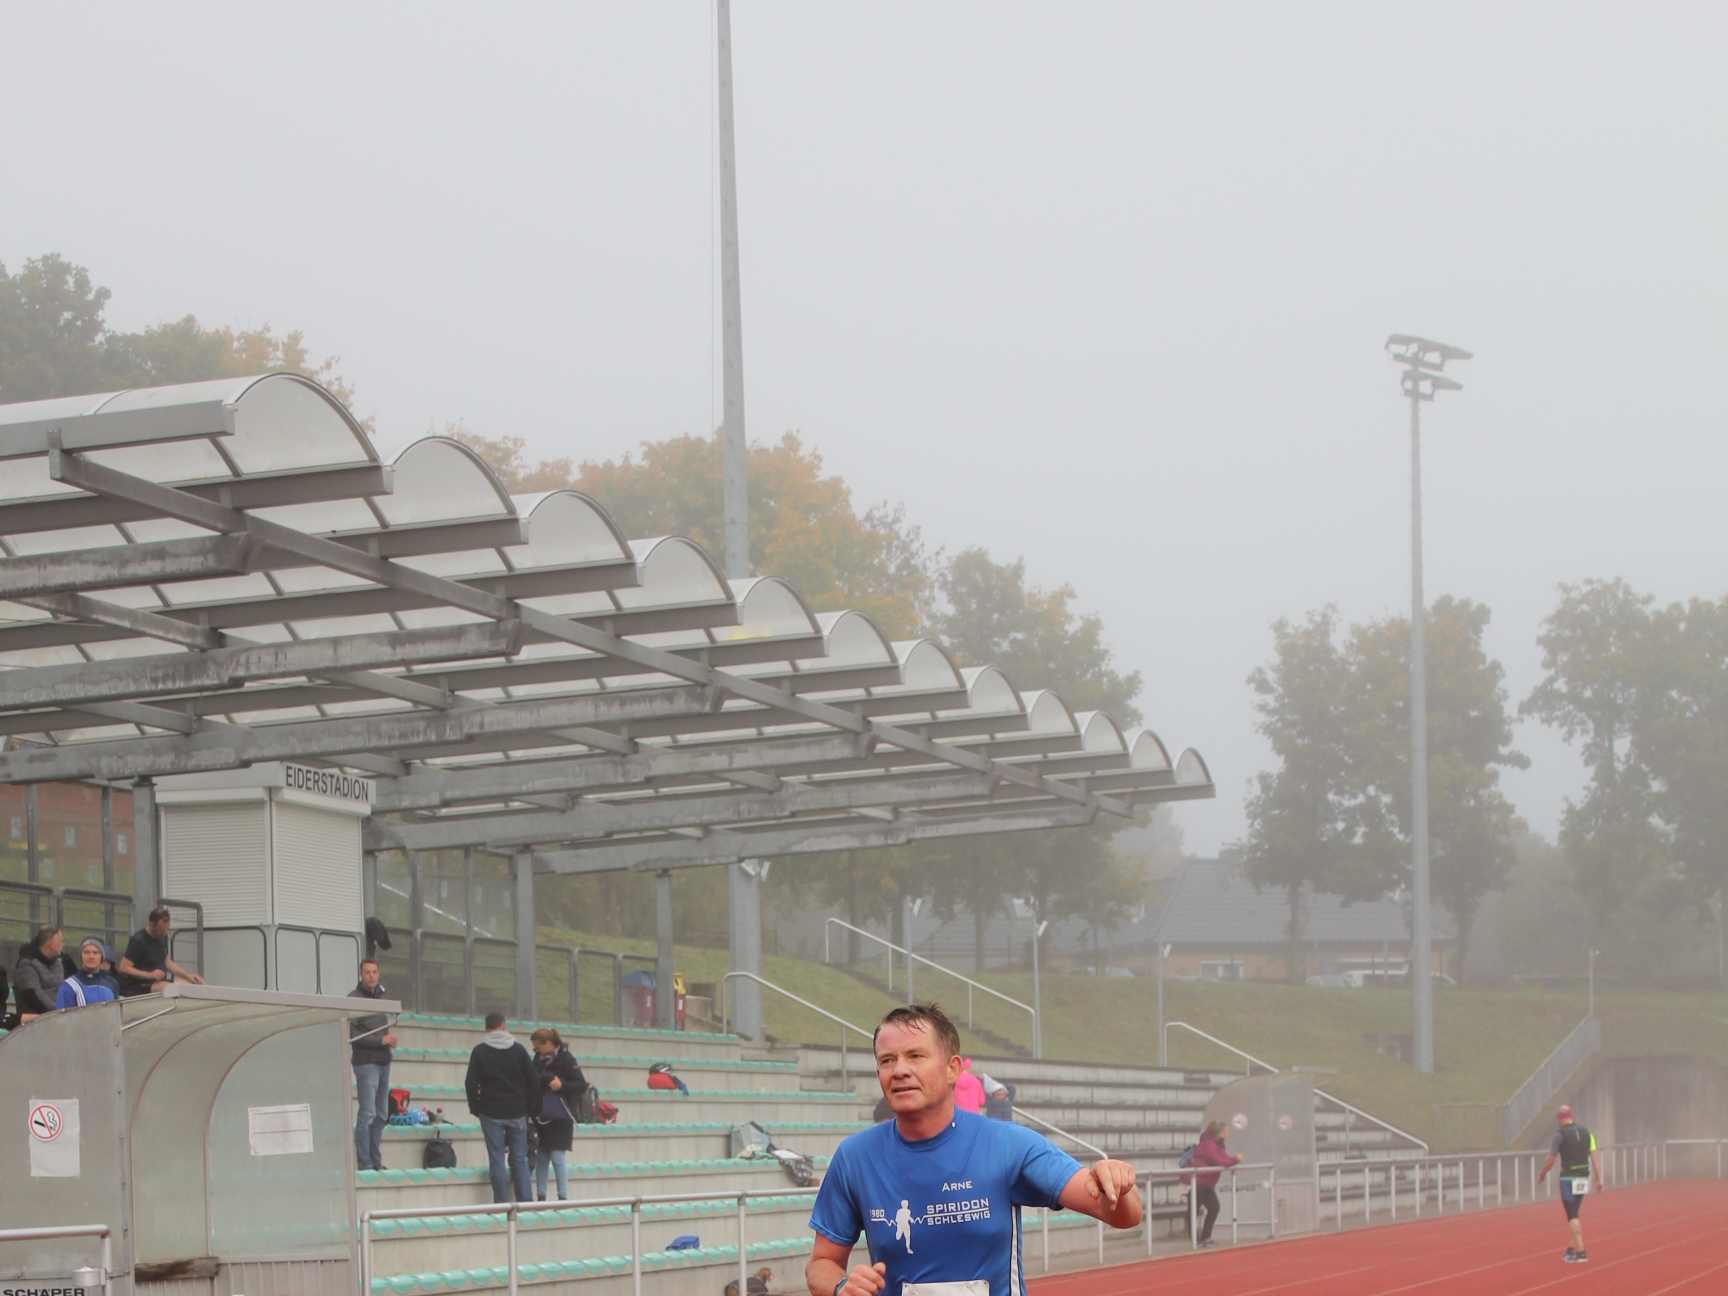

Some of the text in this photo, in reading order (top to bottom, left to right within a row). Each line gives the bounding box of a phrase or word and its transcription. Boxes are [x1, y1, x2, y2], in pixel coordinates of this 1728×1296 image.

[286, 765, 368, 801] EIDERSTADION
[942, 1180, 973, 1192] ARNE
[926, 1197, 989, 1214] SPIRIDON
[927, 1210, 990, 1226] SCHLESWIG
